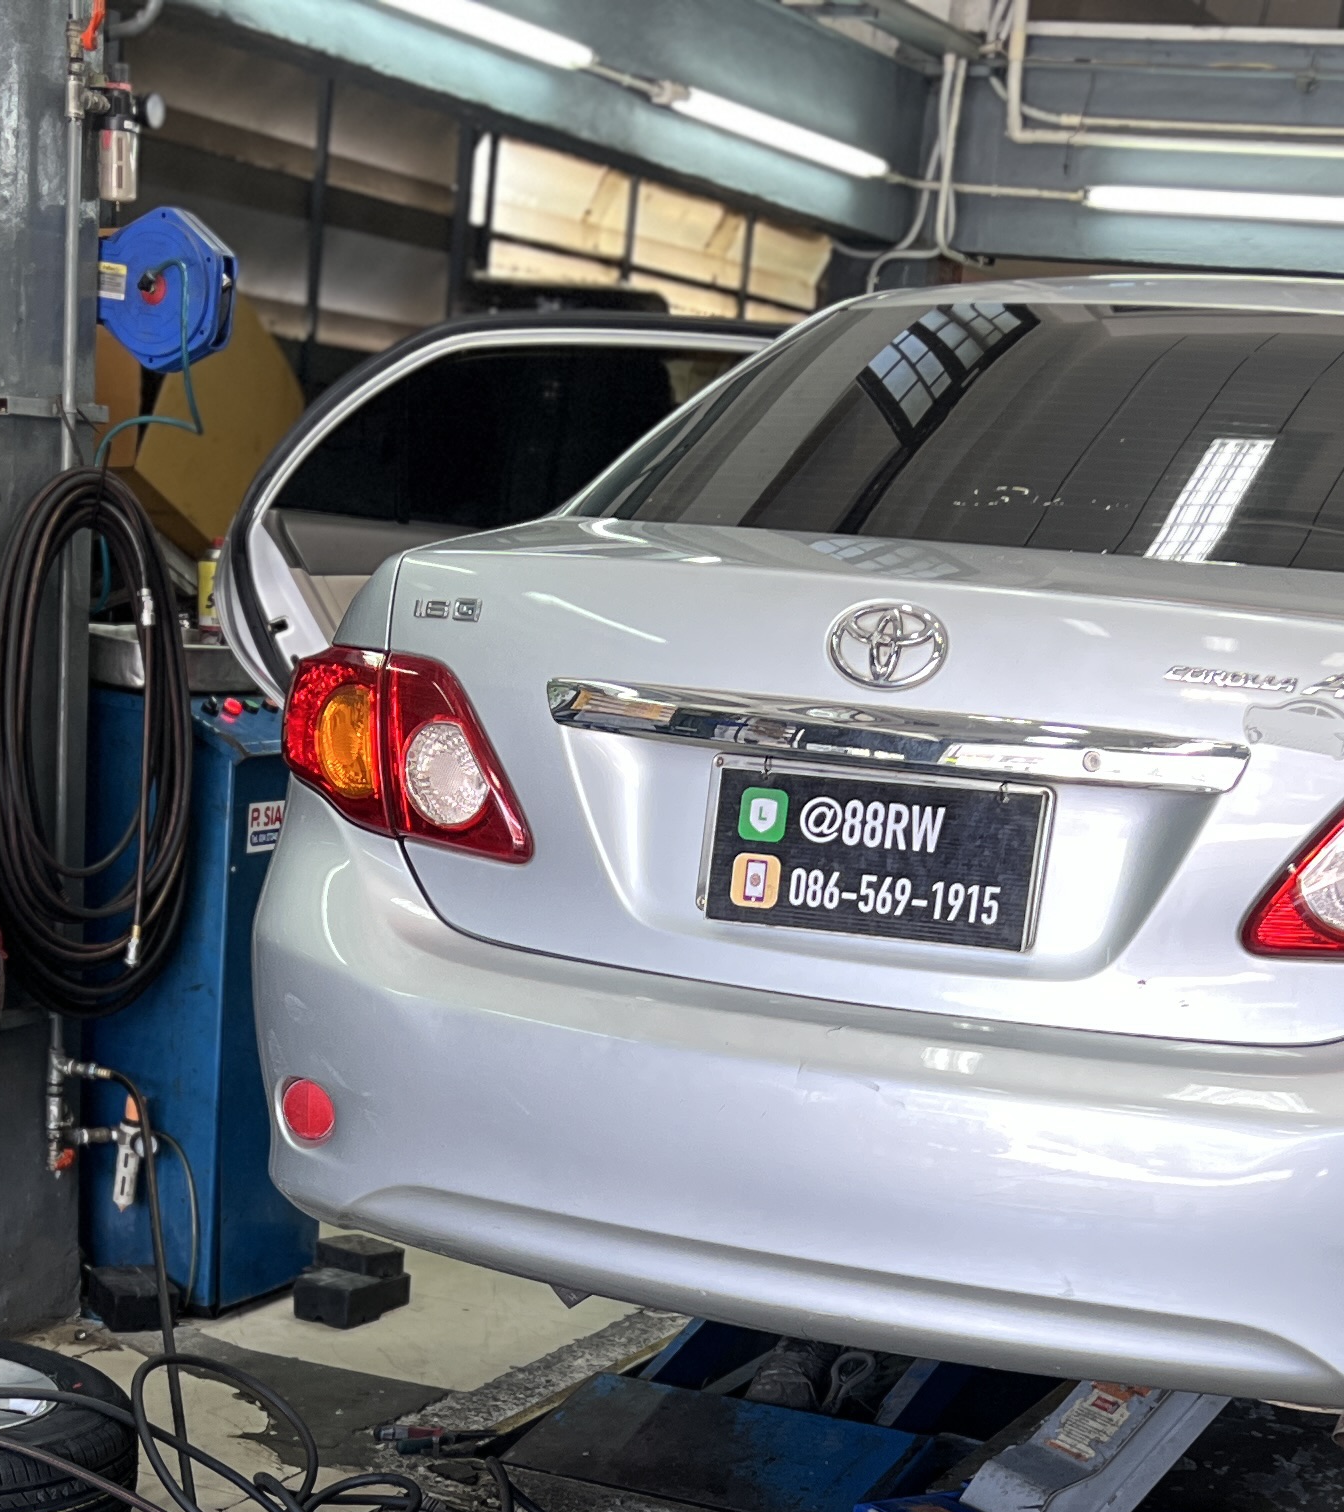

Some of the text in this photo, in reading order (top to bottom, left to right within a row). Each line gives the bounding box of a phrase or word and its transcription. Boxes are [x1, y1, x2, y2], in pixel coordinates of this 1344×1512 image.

[1163, 664, 1299, 693] COROLLA
[263, 804, 284, 827] SIA
[799, 796, 947, 853] @88RW
[789, 867, 1002, 926] 086-569-1915
